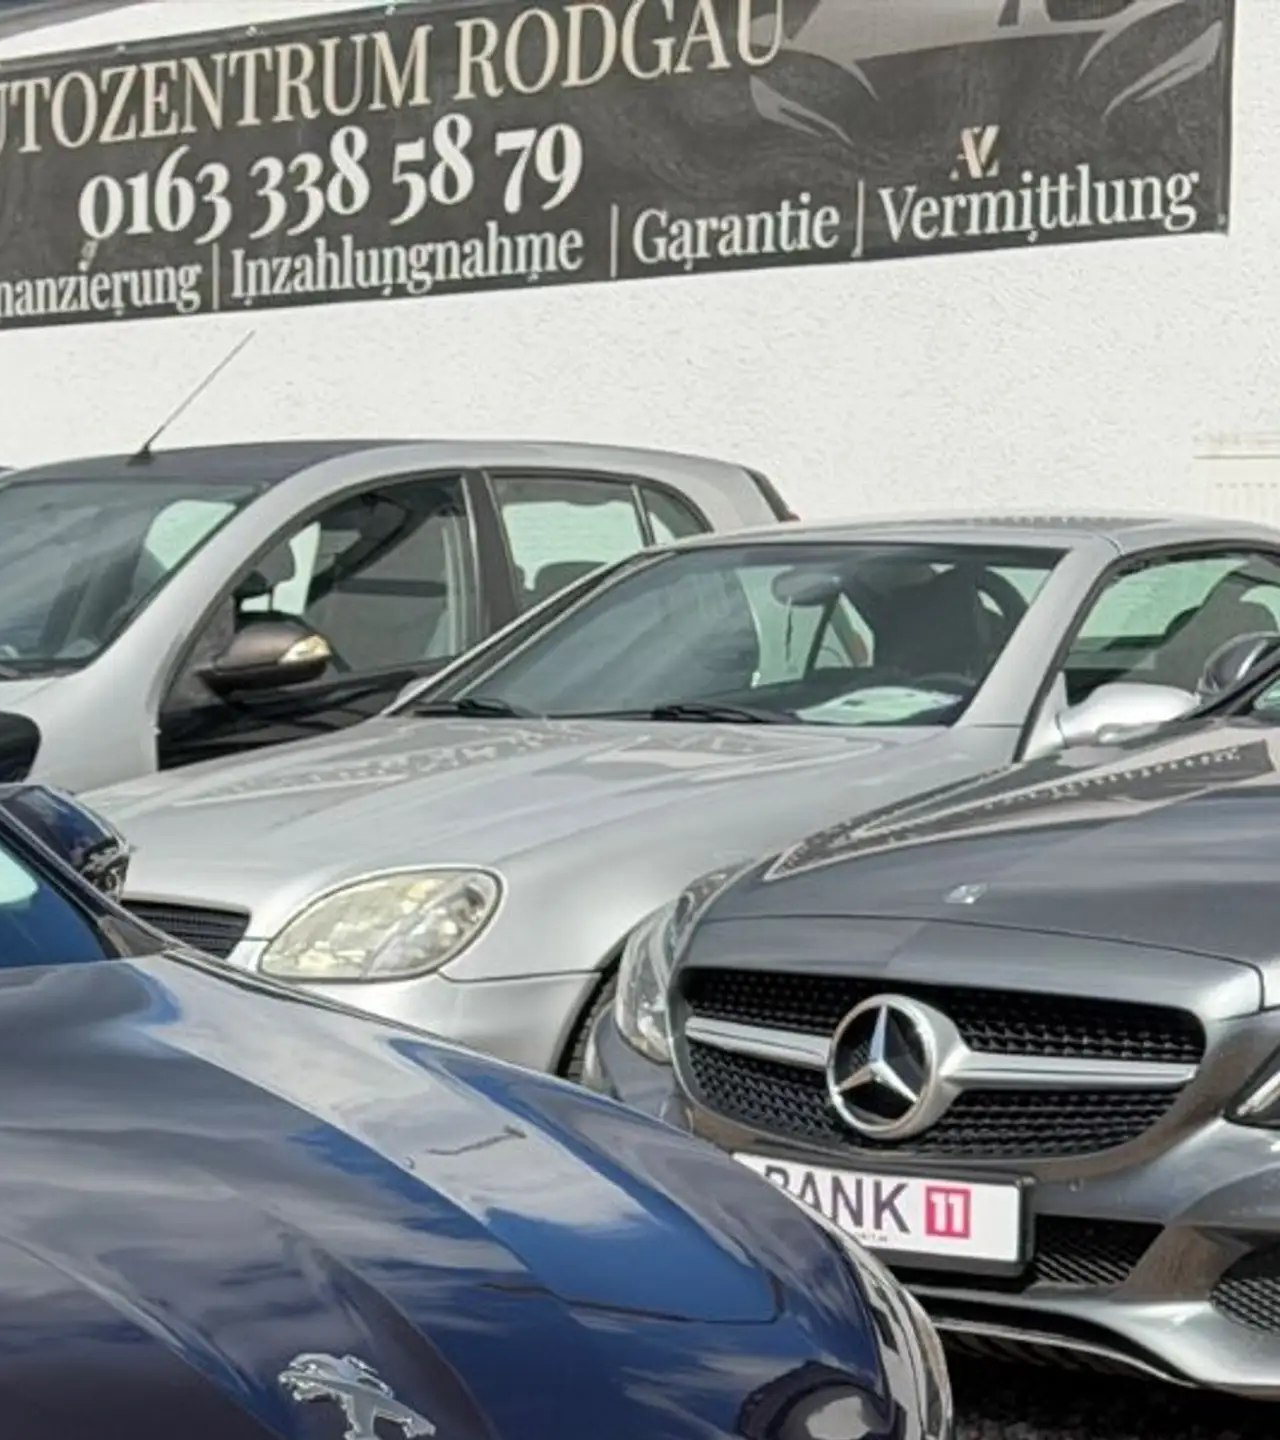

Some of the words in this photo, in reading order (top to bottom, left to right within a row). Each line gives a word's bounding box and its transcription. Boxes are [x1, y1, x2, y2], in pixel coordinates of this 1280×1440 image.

[452, 0, 785, 101] RODGAU
[77, 144, 233, 245] 0163
[249, 124, 371, 240] 338
[388, 112, 475, 227] 58
[495, 122, 585, 215] 79
[230, 219, 585, 302] Inzahlungnahme
[632, 191, 841, 266] Garantie
[876, 164, 1201, 243] Vermittlung
[927, 1188, 968, 1236] 11
